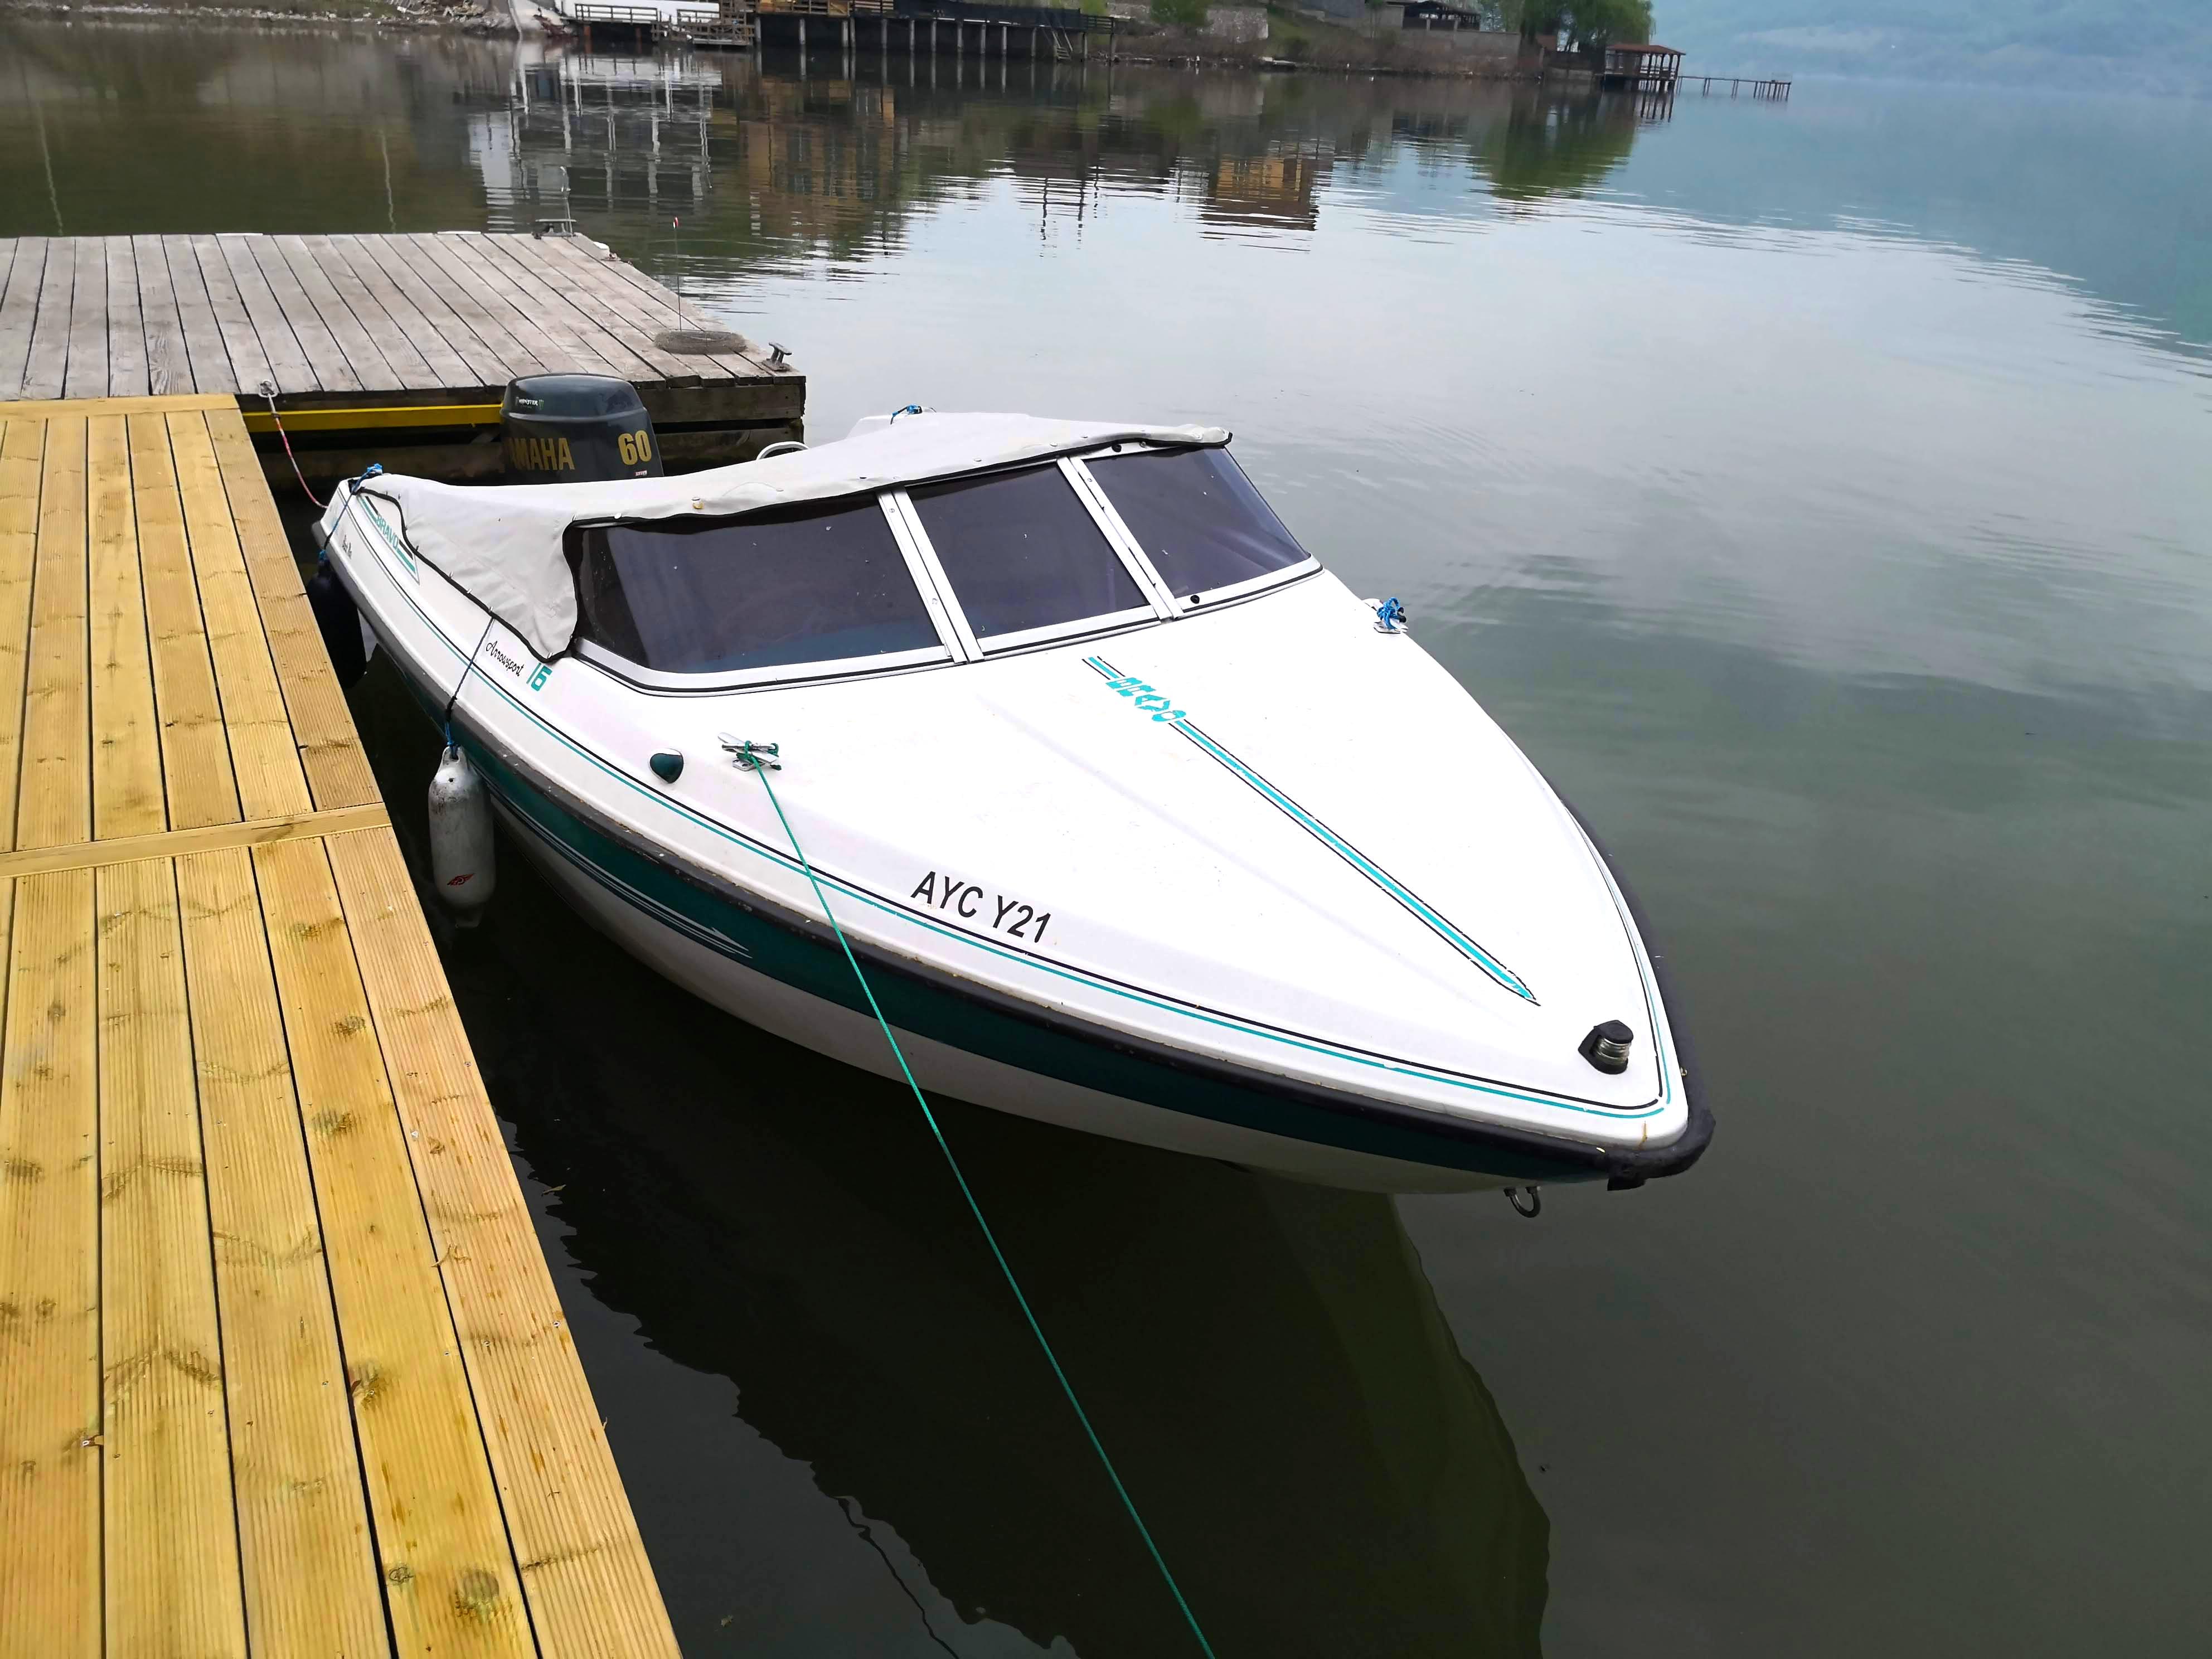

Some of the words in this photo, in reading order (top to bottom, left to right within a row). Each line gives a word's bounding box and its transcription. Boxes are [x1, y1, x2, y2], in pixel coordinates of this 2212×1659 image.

[618, 430, 652, 465] 60
[376, 513, 399, 549] BRAVO
[486, 641, 524, 677] Arrowsport
[526, 662, 552, 692] 16
[910, 871, 983, 918] AYC
[993, 895, 1051, 943] Y21
